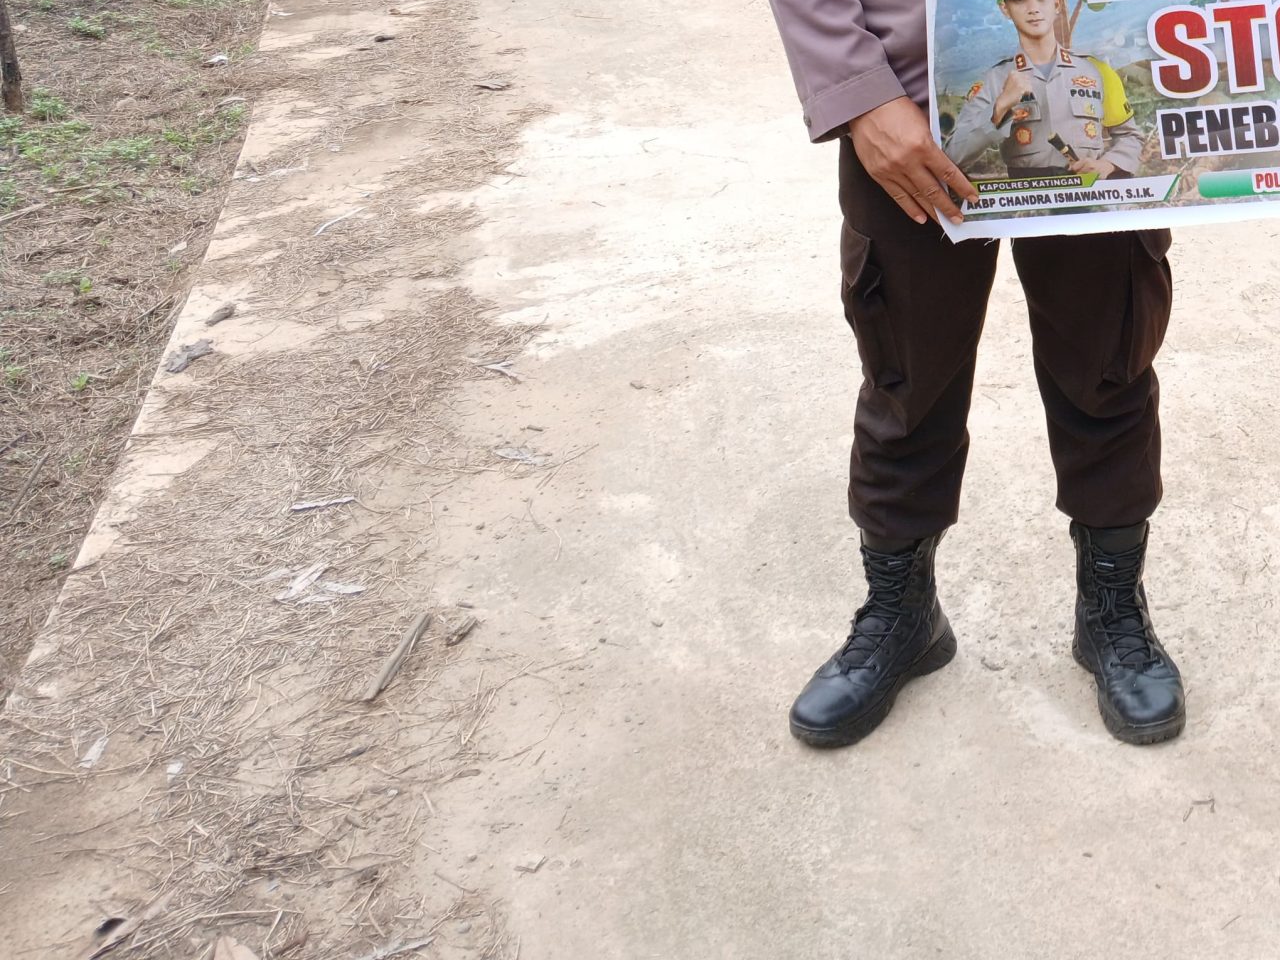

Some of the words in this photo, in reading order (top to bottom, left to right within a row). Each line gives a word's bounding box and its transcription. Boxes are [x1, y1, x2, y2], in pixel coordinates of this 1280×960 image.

[979, 180, 1030, 192] KAPOLRES
[1031, 177, 1081, 188] KATINGAN
[999, 193, 1050, 208] CHANDRA
[1054, 188, 1124, 204] ISMAWANTO,
[1126, 187, 1155, 199] S.I.K.
